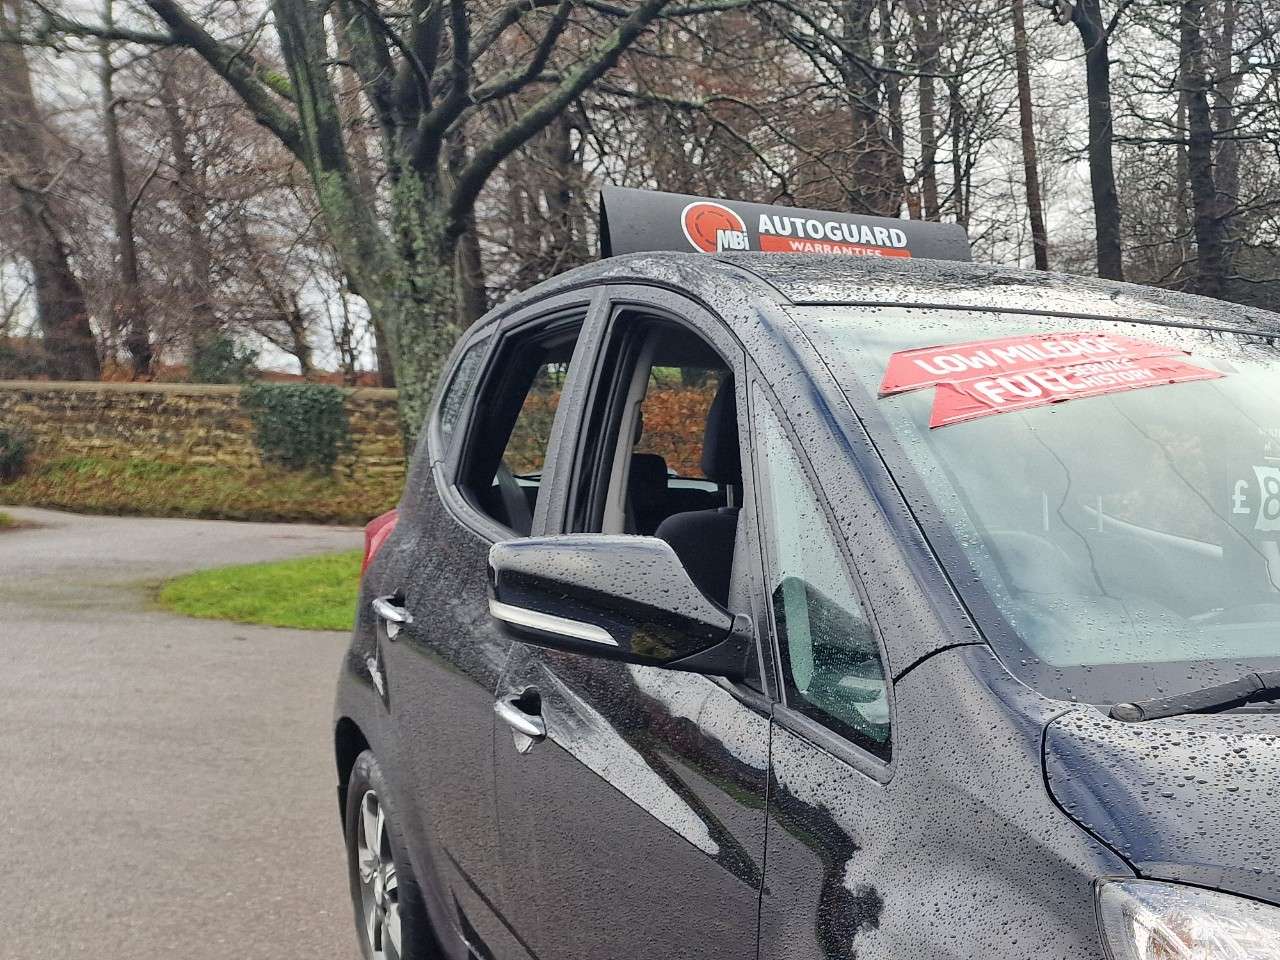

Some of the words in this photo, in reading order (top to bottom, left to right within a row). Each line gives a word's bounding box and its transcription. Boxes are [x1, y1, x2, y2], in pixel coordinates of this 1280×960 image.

[716, 229, 750, 252] MBi
[758, 213, 908, 248] AUTOGUARD
[913, 350, 1000, 376] LOW
[992, 335, 1125, 366] MILEAGE
[1081, 367, 1155, 388] HISTORY
